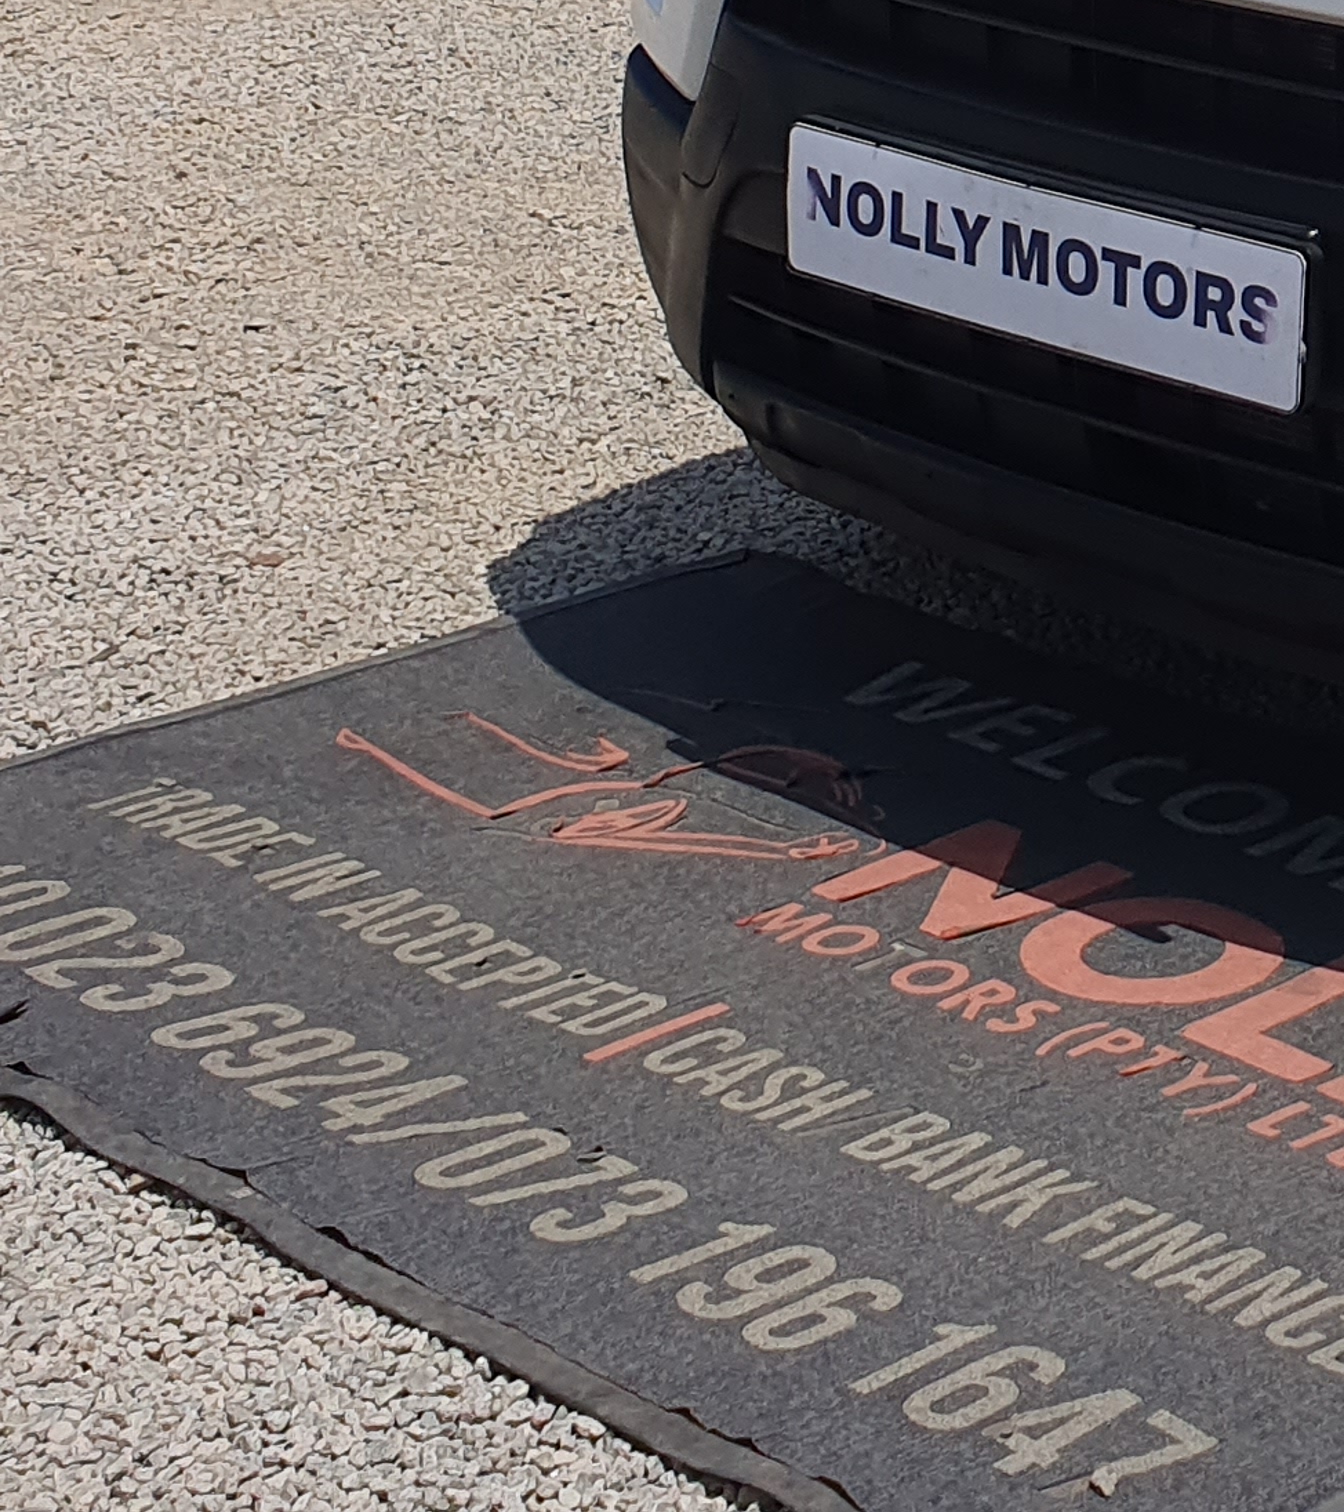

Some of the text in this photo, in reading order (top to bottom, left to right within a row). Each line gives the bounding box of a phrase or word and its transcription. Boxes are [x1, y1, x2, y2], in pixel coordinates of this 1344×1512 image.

[806, 166, 1279, 345] NOLLY MOTORS
[87, 777, 317, 869] TRADE
[252, 851, 383, 902] IN
[734, 902, 1062, 1033] MOTORS
[0, 906, 237, 1013] 023
[629, 1219, 903, 1353] 196
[850, 1317, 1219, 1500] 1647
